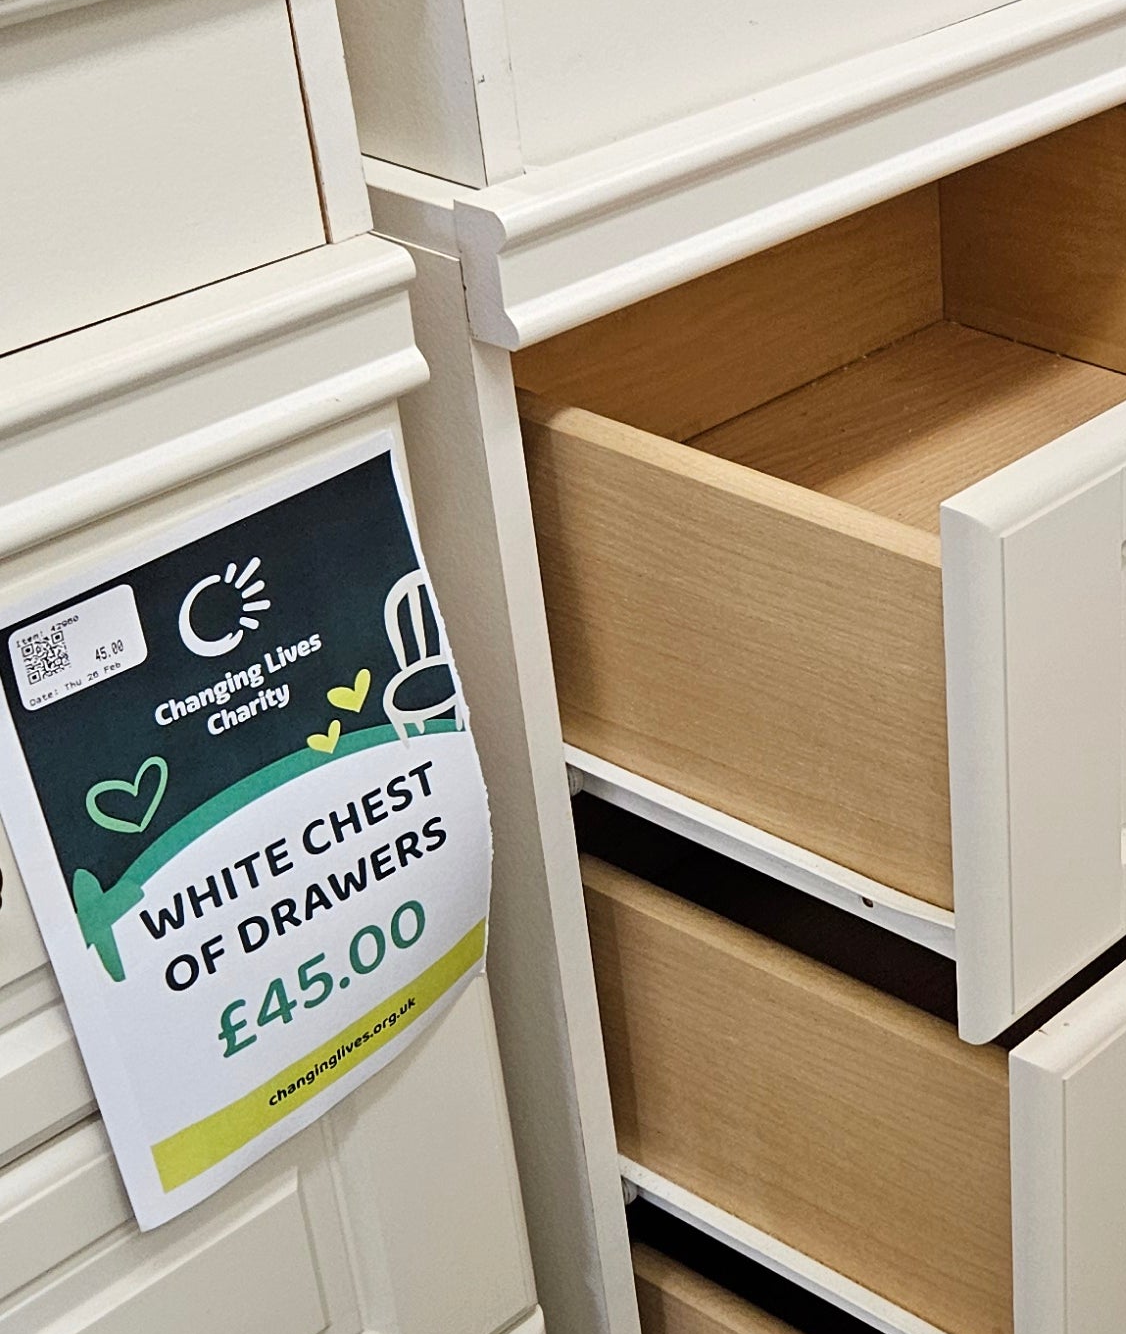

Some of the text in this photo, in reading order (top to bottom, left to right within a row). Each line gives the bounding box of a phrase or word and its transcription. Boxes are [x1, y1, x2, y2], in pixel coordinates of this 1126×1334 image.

[16, 630, 43, 648] Item:
[29, 689, 59, 706] Date:
[64, 678, 82, 691] Thu
[103, 662, 121, 674] Feb
[95, 639, 124, 661] 45.00
[154, 633, 322, 726] Changing Lives
[207, 684, 290, 735] Charity
[139, 760, 433, 940] WHITE CHEST
[165, 816, 447, 992] OF DRAWERS
[218, 899, 426, 1059] £45.00
[268, 997, 416, 1106] changinglives.org.uk
